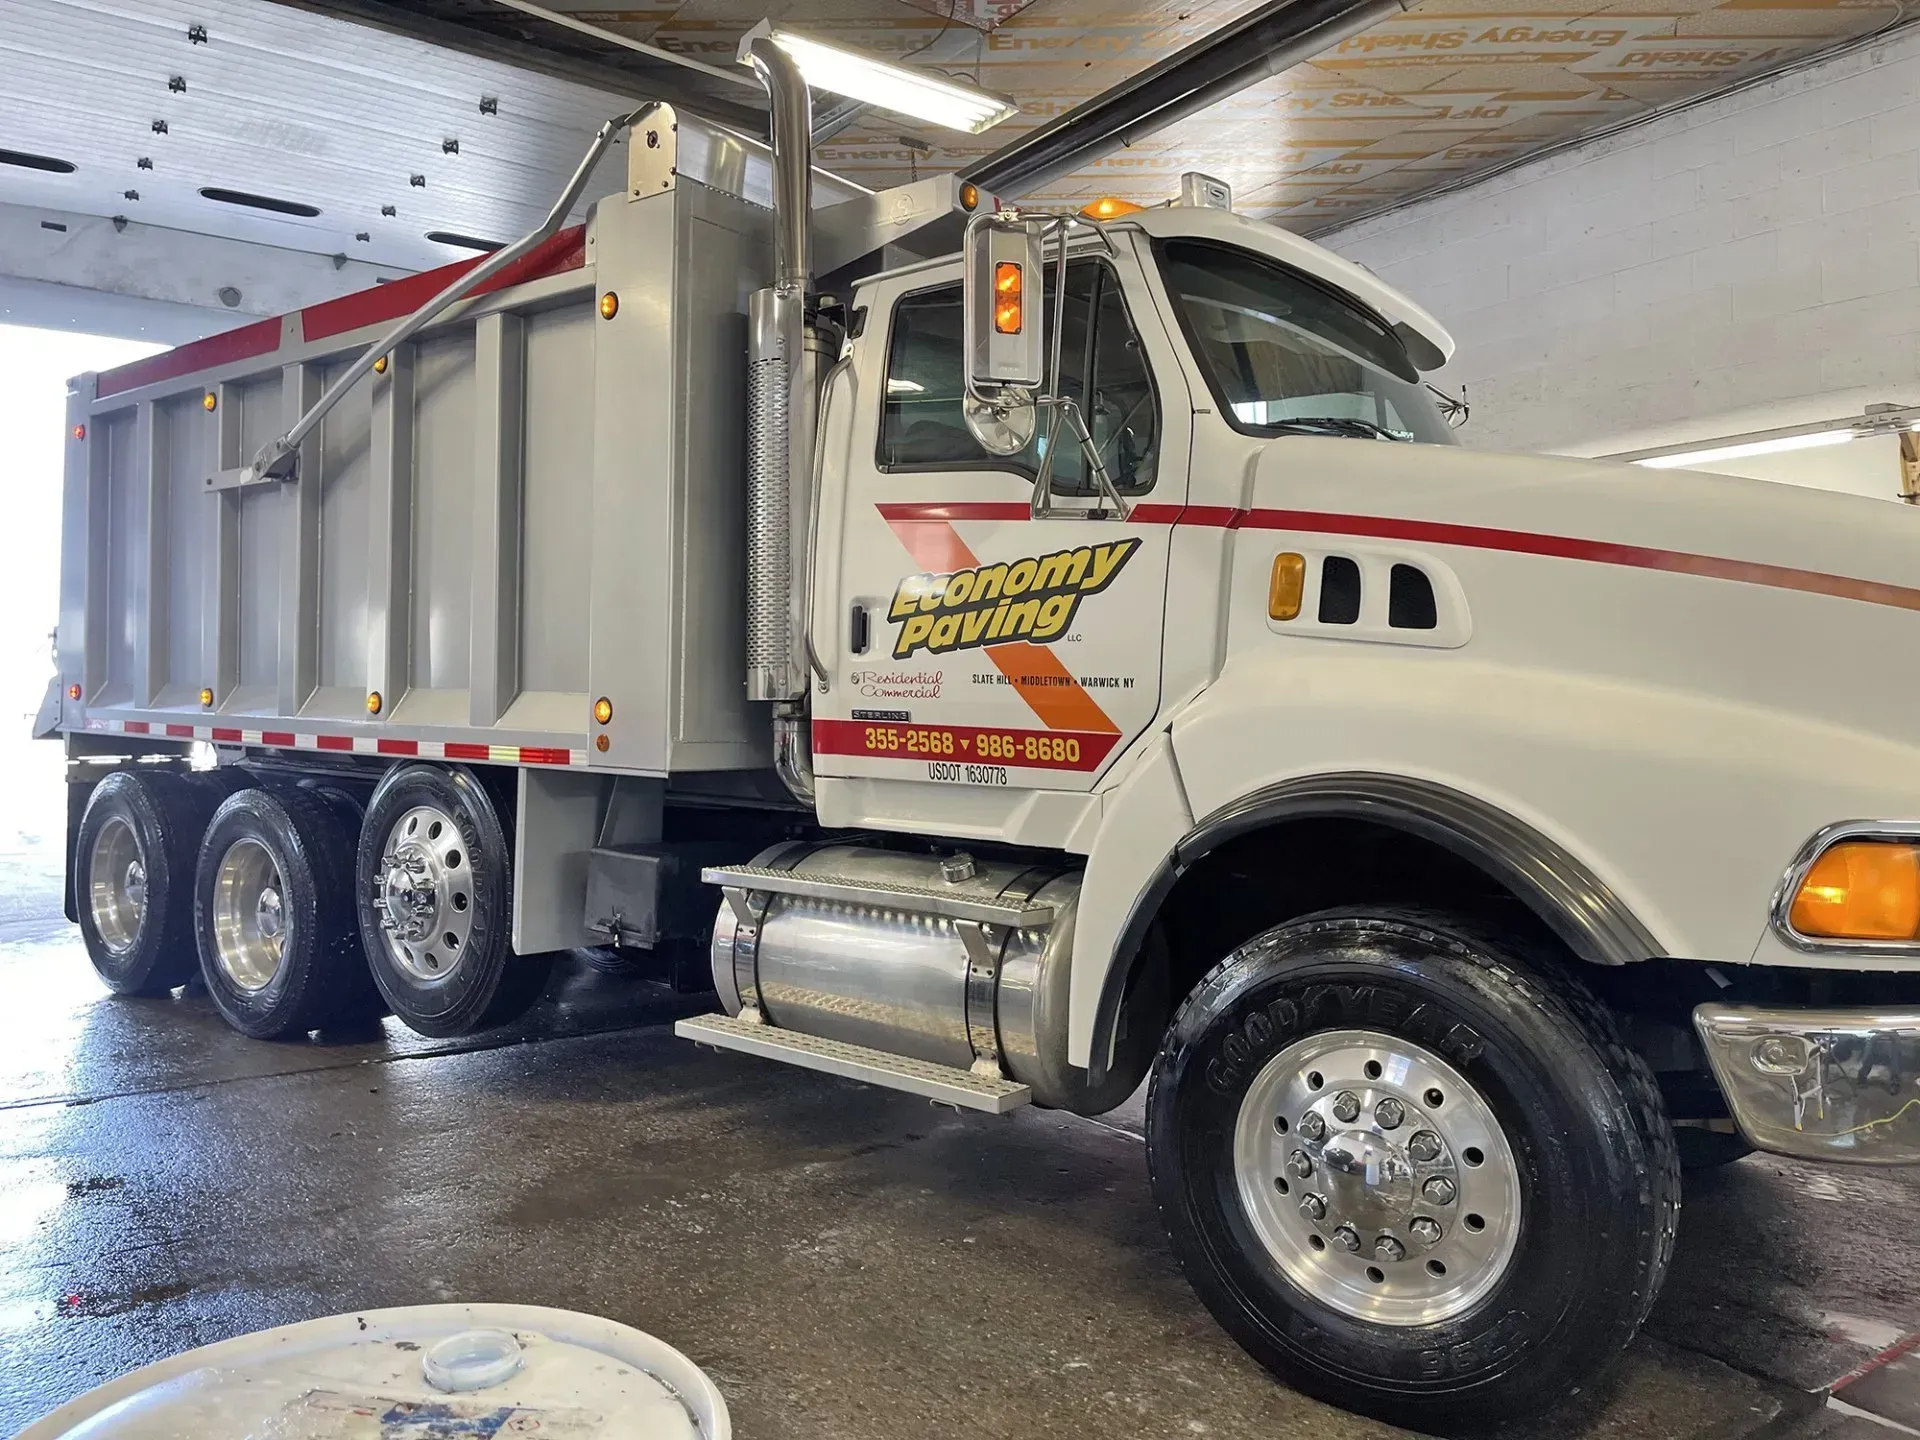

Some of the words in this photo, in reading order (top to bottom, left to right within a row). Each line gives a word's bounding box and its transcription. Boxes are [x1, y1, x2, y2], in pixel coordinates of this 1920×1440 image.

[655, 36, 736, 53] Ene
[989, 33, 1133, 51] Energy
[1336, 31, 1468, 54] Shield
[1472, 26, 1628, 47] Energy
[1616, 51, 1749, 68] Shield
[816, 150, 935, 161] Energy
[888, 539, 1138, 621] Economy
[893, 593, 1079, 658] Paving
[1067, 634, 1082, 643] LLC
[860, 670, 943, 685] Residential
[972, 674, 994, 685] SLATE
[997, 675, 1012, 685] HILL
[1020, 676, 1071, 687] MIDDLETOWN
[1080, 677, 1120, 688] WARWICK
[1123, 677, 1135, 688] NY
[860, 684, 941, 699] Commercial
[853, 710, 908, 720] STERLING
[865, 727, 954, 754] 355-2568
[976, 733, 1080, 763] 986-8680
[928, 762, 961, 782] USDOT
[965, 764, 1008, 785] 1630778
[1205, 983, 1484, 1096] GOODYEAR
